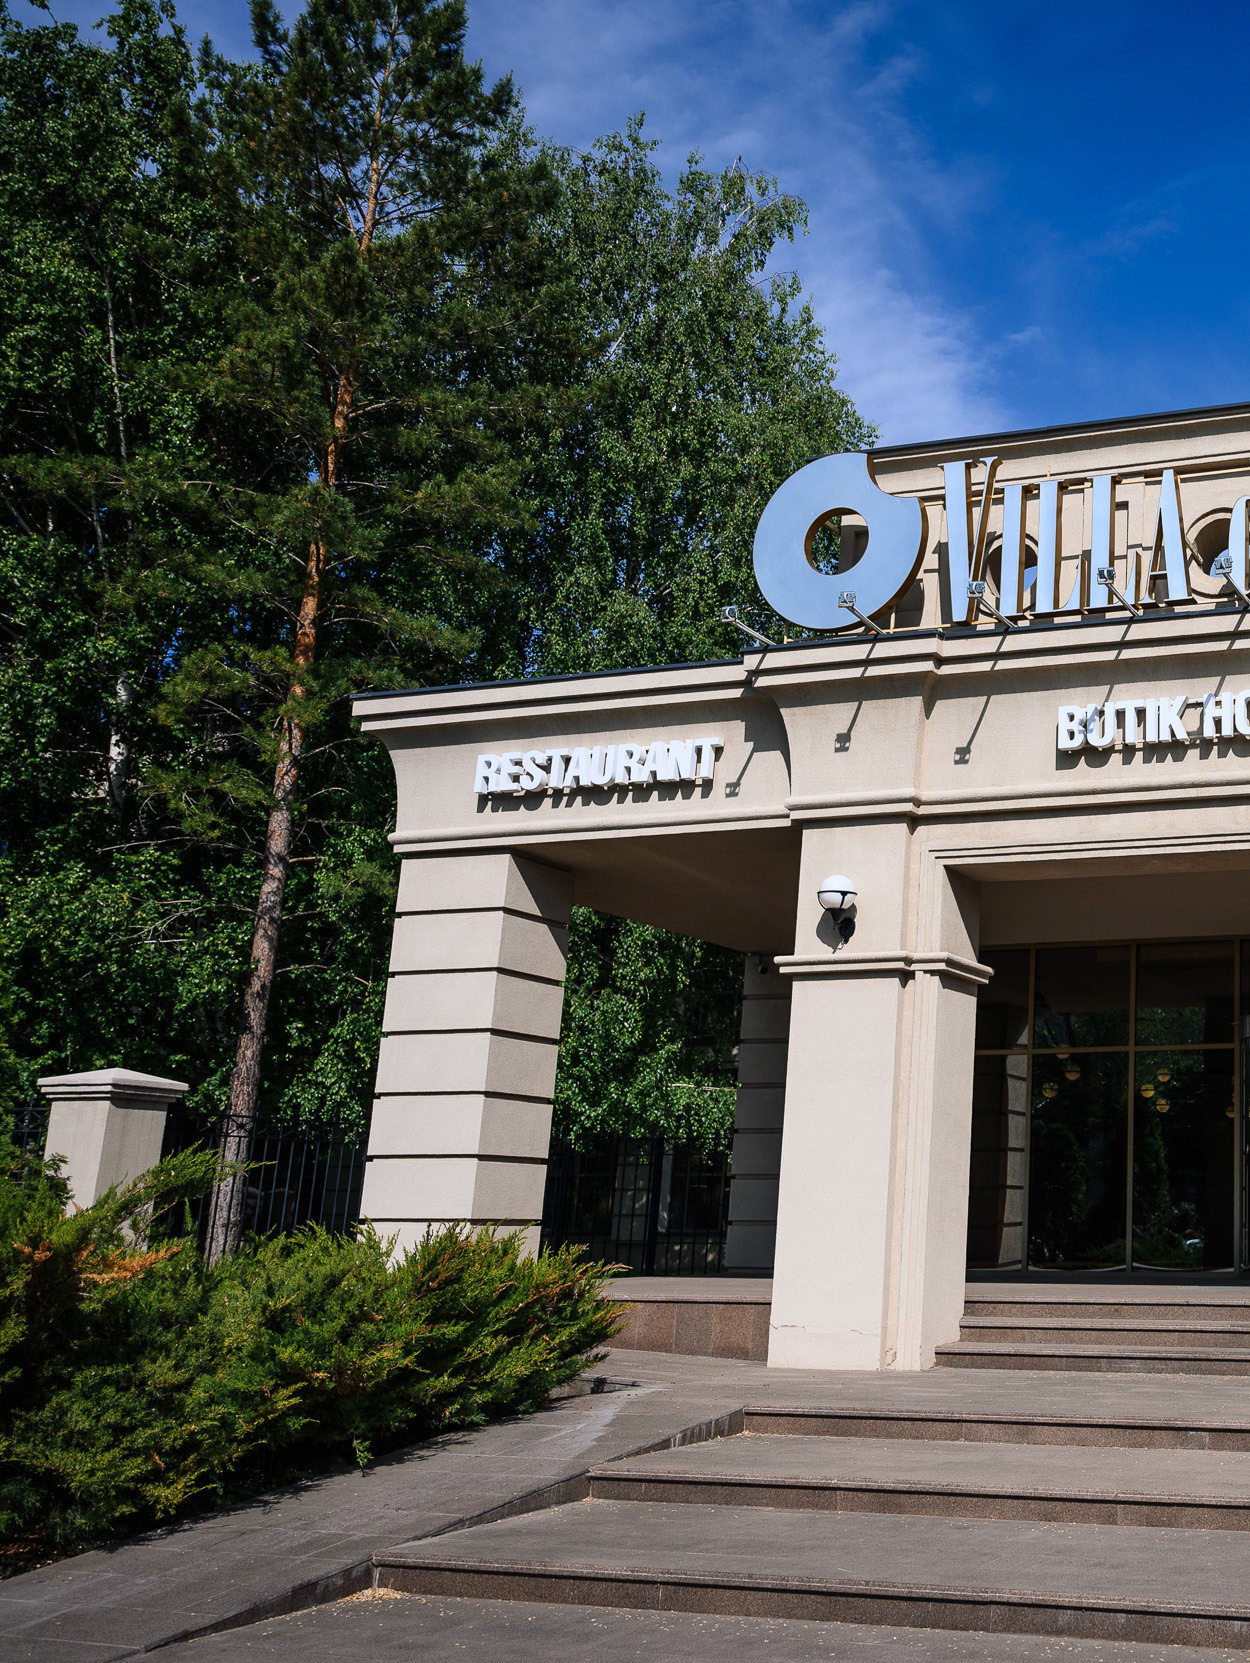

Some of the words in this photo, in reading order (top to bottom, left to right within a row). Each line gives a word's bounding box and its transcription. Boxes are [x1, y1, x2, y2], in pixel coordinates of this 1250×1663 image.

[938, 456, 1197, 625] VILLA
[1057, 695, 1191, 751] BUTIK
[474, 736, 725, 795] RESTAURANT
